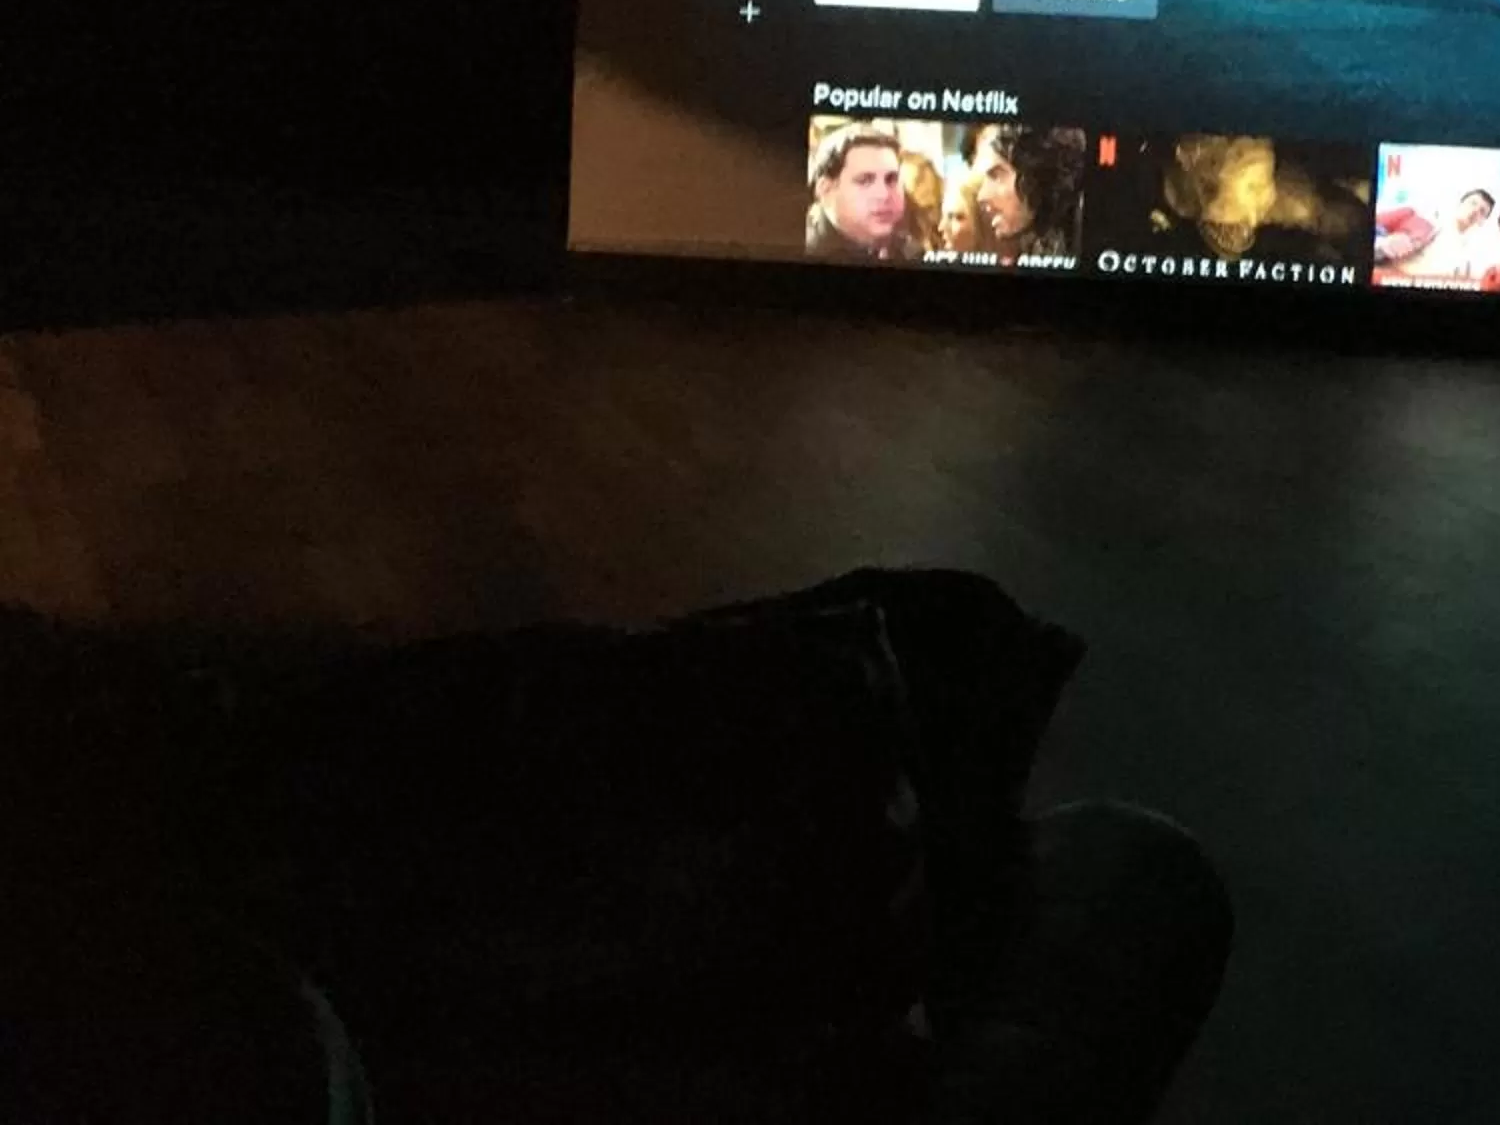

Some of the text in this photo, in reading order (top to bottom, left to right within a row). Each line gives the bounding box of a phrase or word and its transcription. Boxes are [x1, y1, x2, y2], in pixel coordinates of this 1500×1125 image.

[813, 82, 1018, 114] Popular on Netflix
[1098, 249, 1228, 279] OCTOBER
[1239, 259, 1356, 284] FACTION
